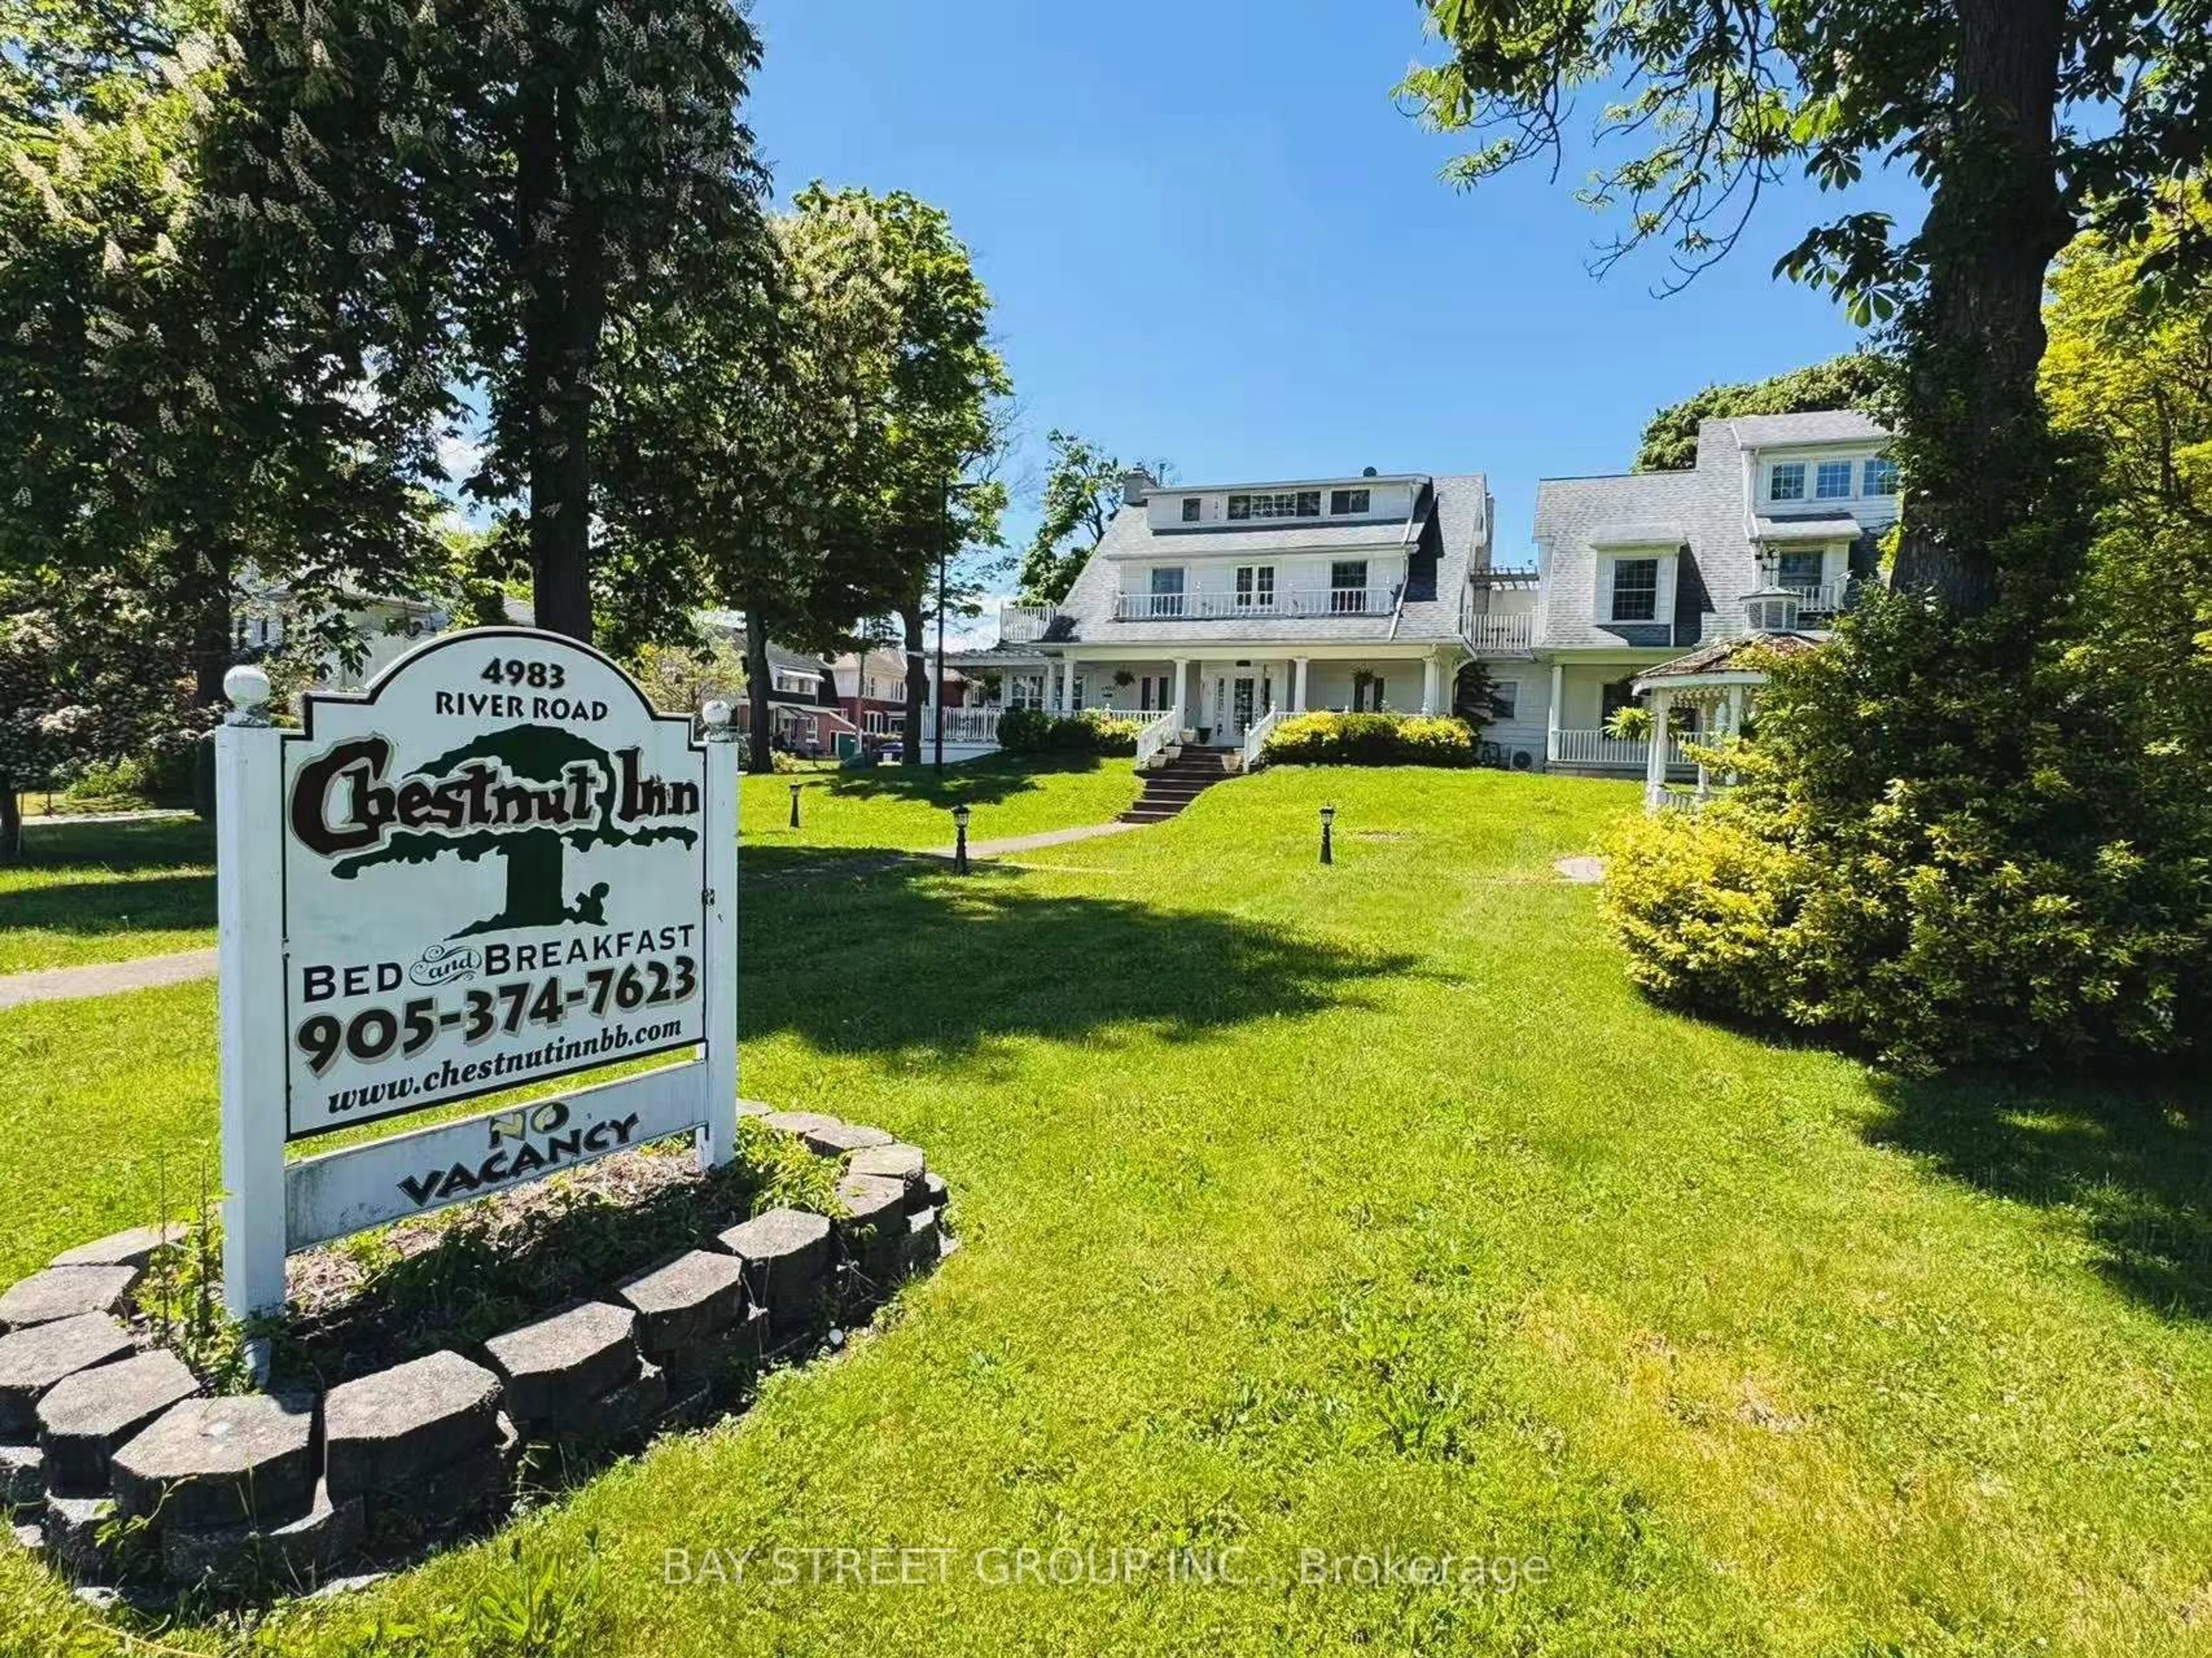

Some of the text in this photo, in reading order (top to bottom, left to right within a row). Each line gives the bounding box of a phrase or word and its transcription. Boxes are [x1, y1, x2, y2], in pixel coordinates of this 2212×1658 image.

[435, 692, 608, 722] RIVER ROAD
[481, 657, 566, 689] 4983
[287, 733, 700, 858] Chestnut Inn
[303, 924, 695, 1003] BED and BREAKFAST
[295, 956, 698, 1079] 905-374-7623
[328, 1017, 682, 1114] www.chestnutinnbb.com
[397, 1113, 639, 1208] VACANCY
[489, 1102, 569, 1149] NO
